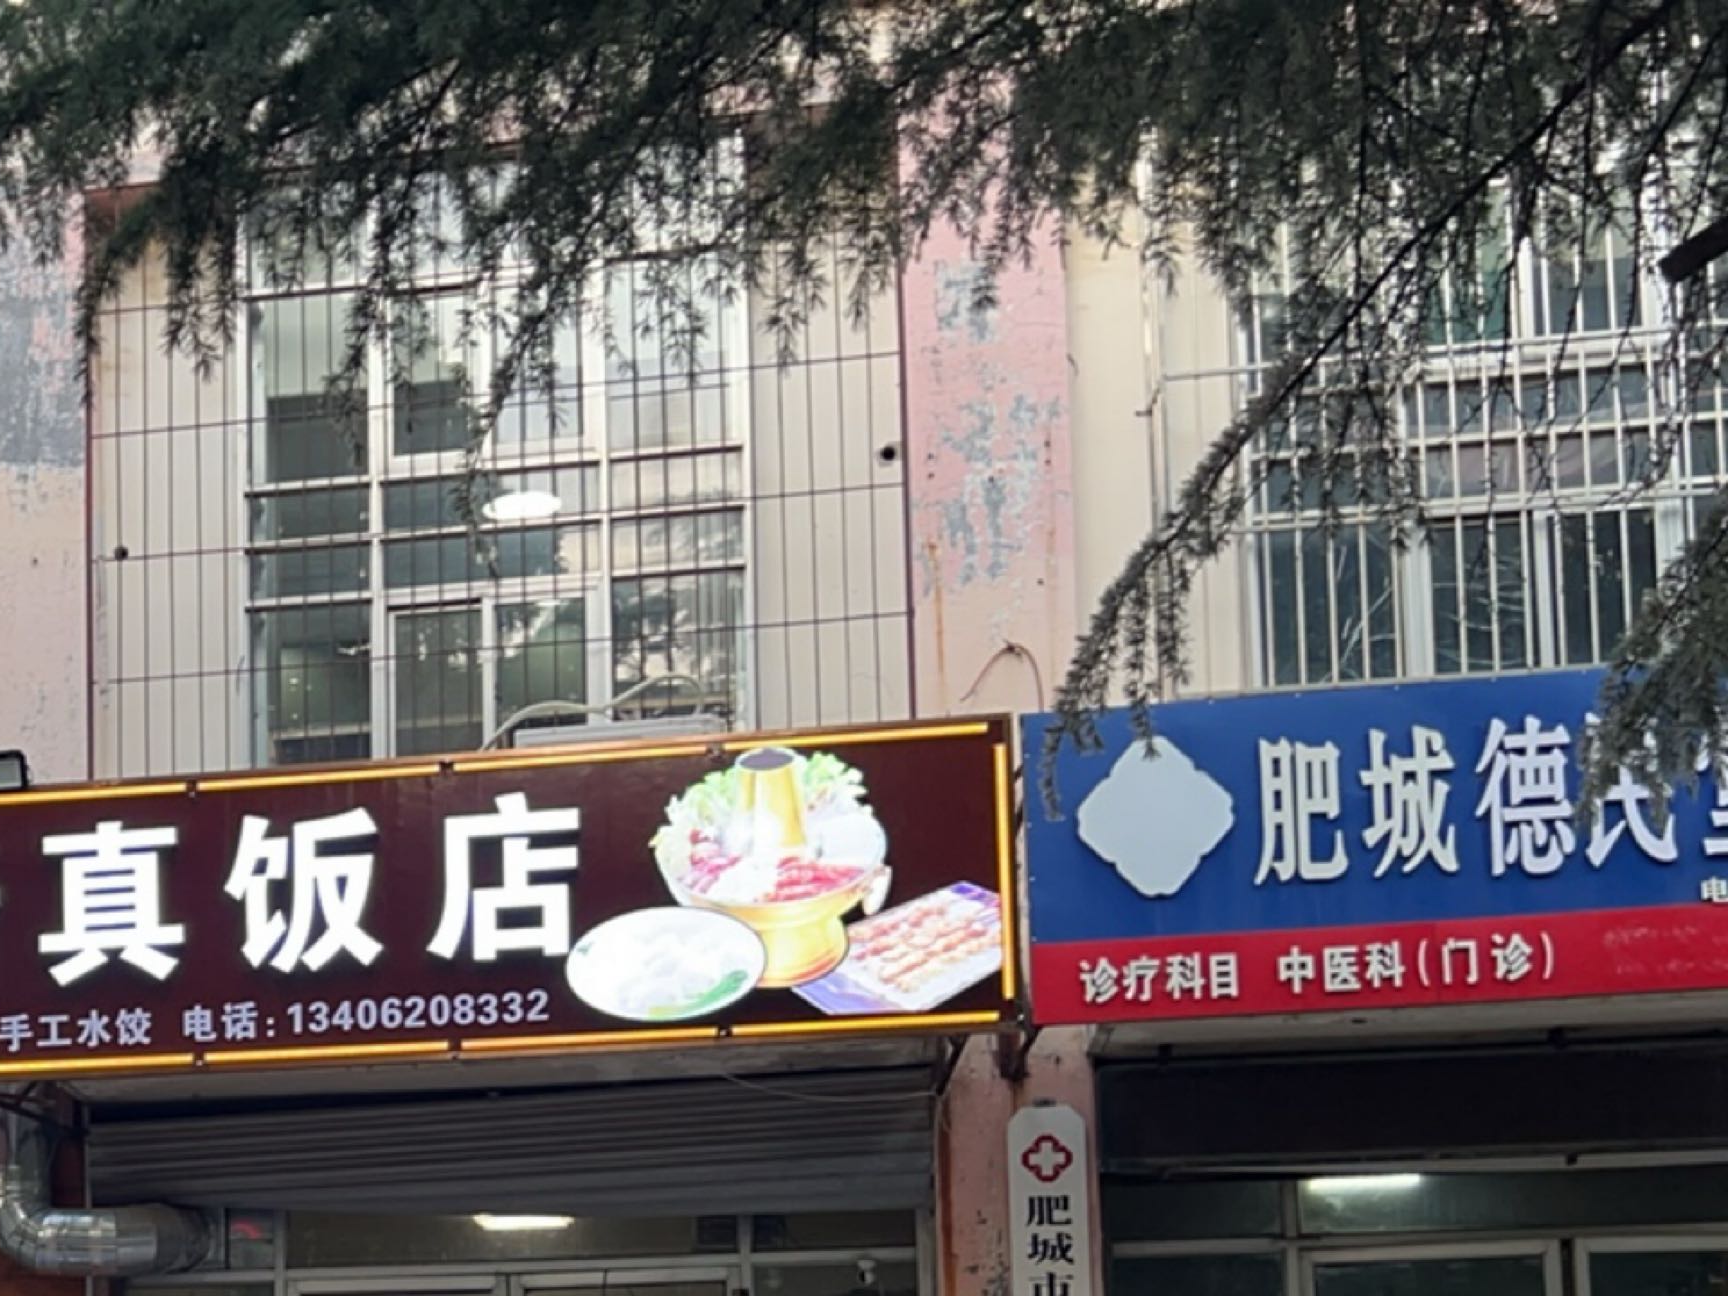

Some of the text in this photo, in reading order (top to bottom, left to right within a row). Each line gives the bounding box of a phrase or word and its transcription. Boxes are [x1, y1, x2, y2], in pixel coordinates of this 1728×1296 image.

[1079, 932, 1555, 1004] 诊疗科目 中医科(门诊)
